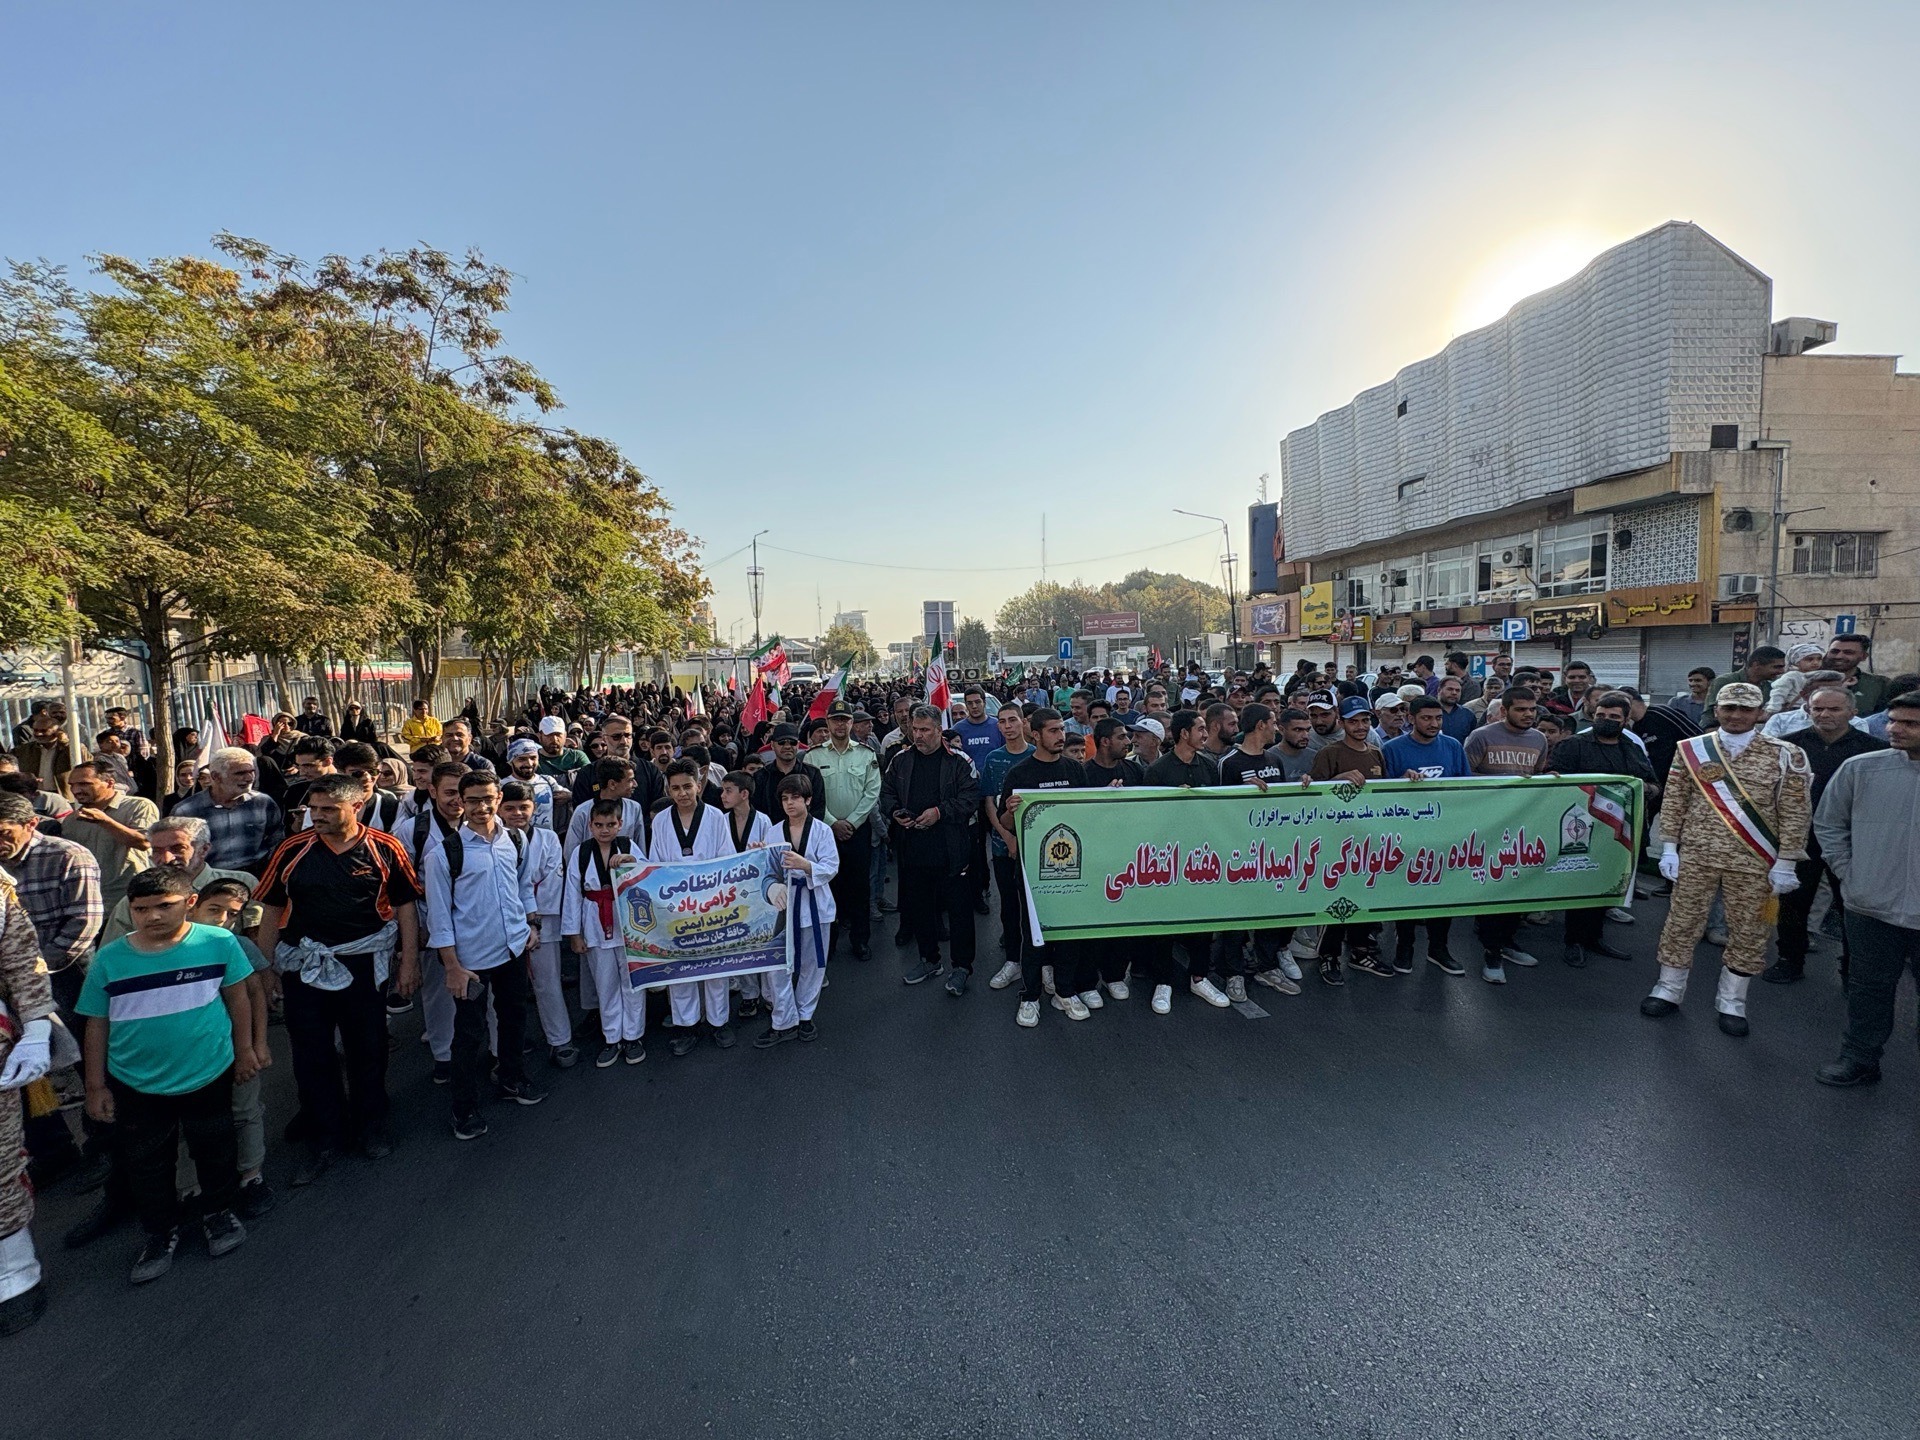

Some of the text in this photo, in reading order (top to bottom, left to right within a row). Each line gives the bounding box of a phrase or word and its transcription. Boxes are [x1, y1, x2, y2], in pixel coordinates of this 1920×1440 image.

[1627, 594, 1696, 618] کفش نسیم
[1535, 612, 1563, 624] بستنی
[1507, 621, 1523, 639] P
[1473, 655, 1483, 671] P
[968, 737, 990, 746] MOVE
[1257, 765, 1281, 779] adida
[1292, 807, 1318, 826] ایران
[1356, 804, 1374, 819] ملت
[1104, 826, 1547, 902] همایش پیاده روی خانوادگی گرامیداشت هفته انتظامی
[658, 862, 760, 900] هفته انتظامی
[677, 886, 737, 915] گرامی باد
[675, 907, 740, 935] کمربند ایمنی
[679, 925, 746, 946] حافظ جان شماست
[756, 953, 767, 961] پلیس
[680, 963, 693, 972] رضوی
